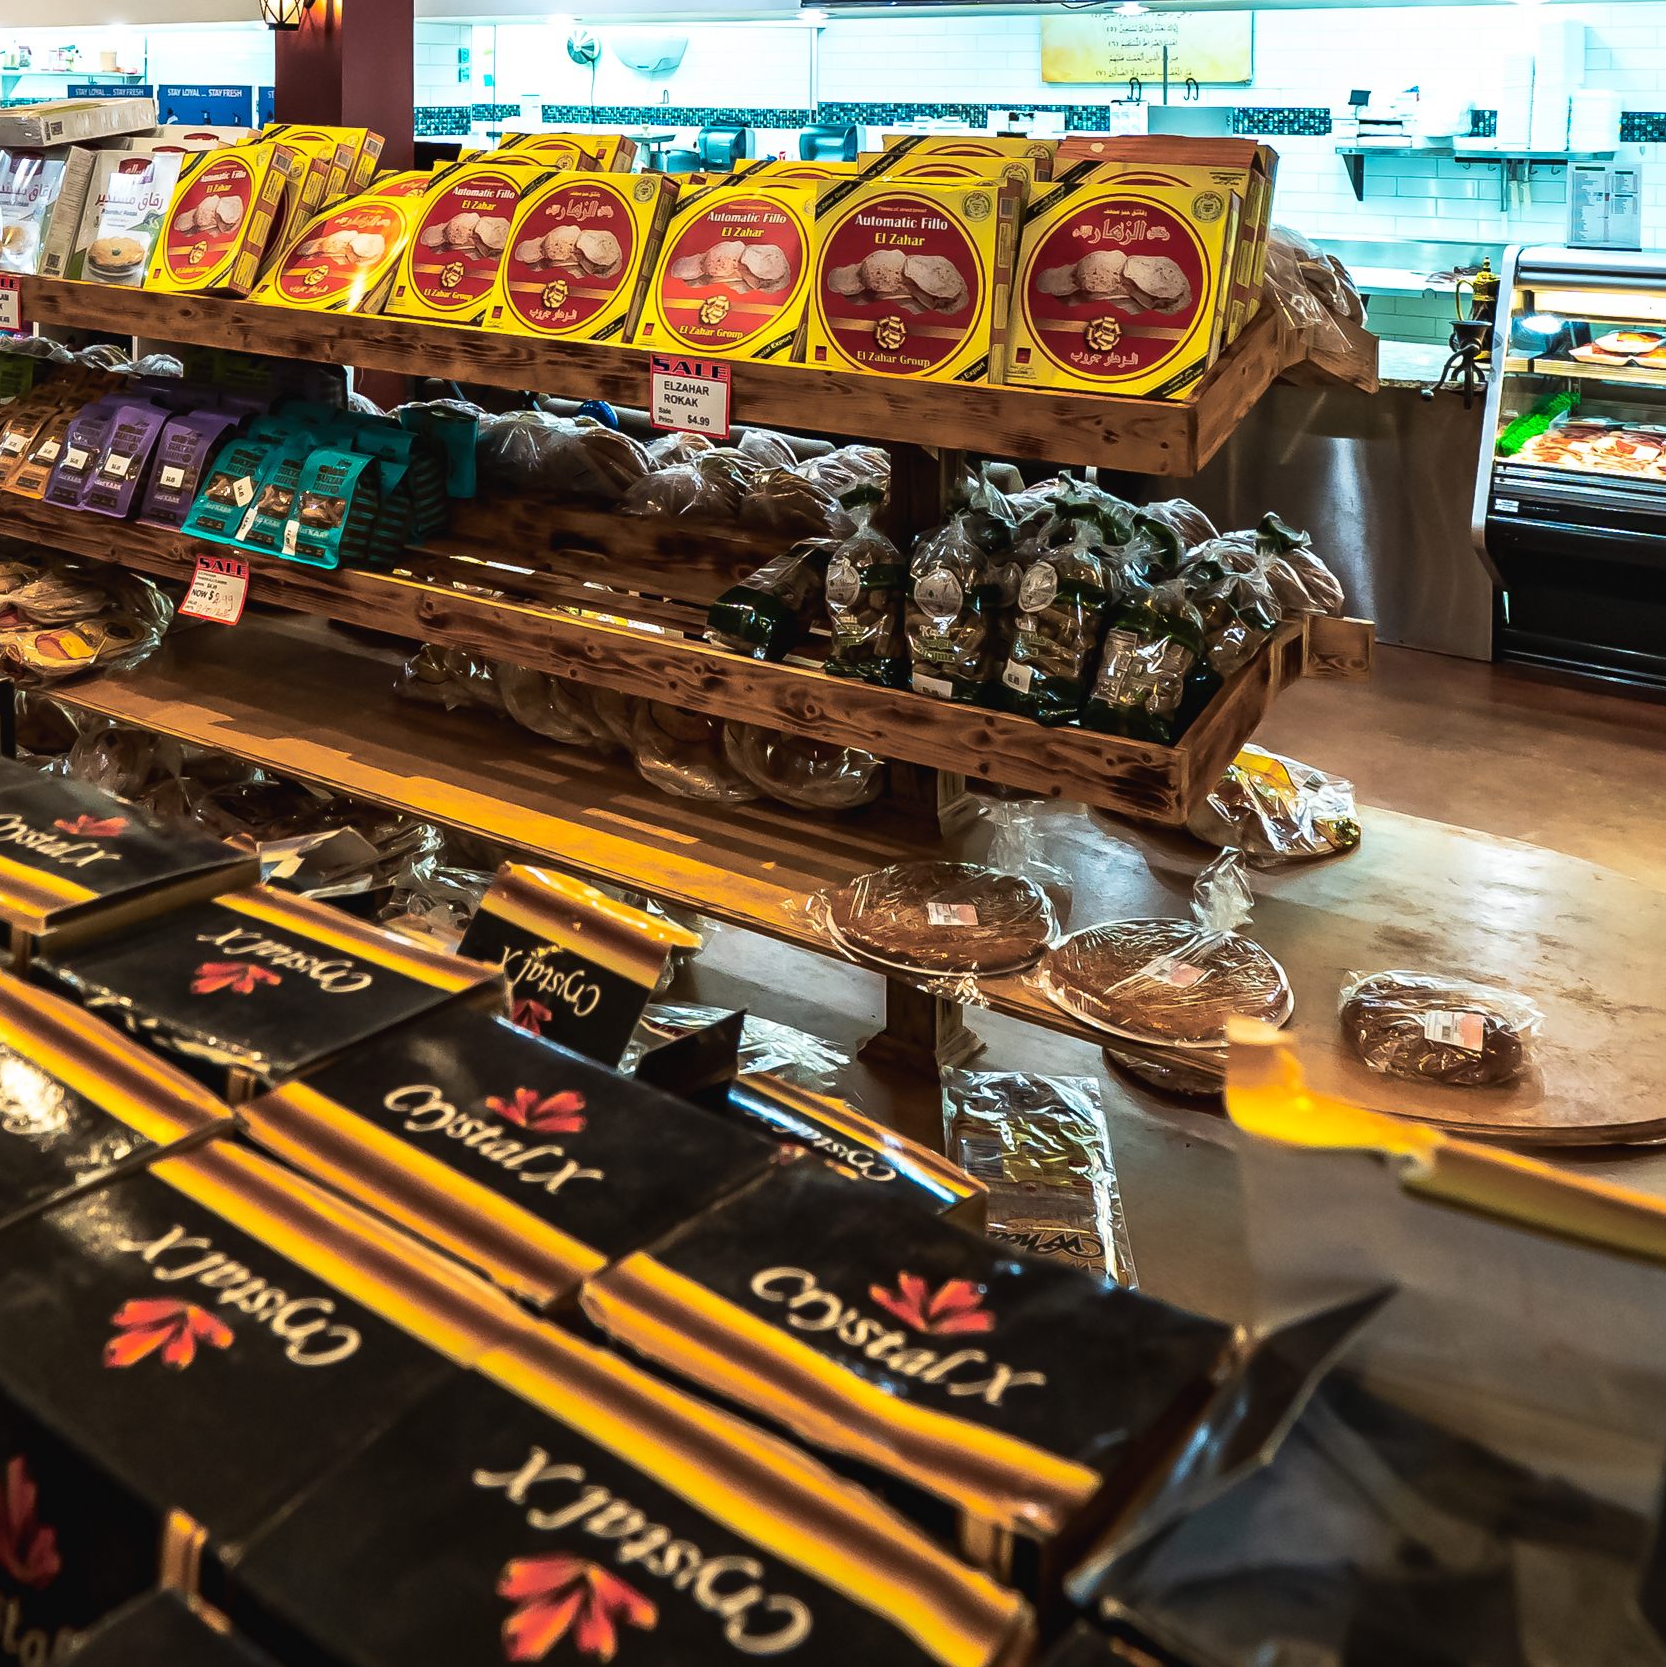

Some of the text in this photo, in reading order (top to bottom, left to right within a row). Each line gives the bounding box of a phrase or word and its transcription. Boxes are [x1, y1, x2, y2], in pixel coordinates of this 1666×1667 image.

[75, 88, 144, 96] STAY LOYAL STAY FRESH
[167, 88, 242, 97] STAY LOYAL STAY FRESH
[452, 187, 516, 199] Automatic Fillo
[461, 200, 497, 211] El Zahar
[707, 211, 786, 224] Automatic Fillo
[855, 214, 948, 231] Automatic Fillo
[722, 227, 764, 238] El Zahar
[875, 233, 925, 246] El Zahar
[679, 325, 743, 341] El Zahar Group
[770, 334, 793, 350] Export
[857, 351, 931, 368] El Zahar Group
[653, 356, 727, 381] SALE
[964, 361, 986, 380] Export
[664, 381, 709, 396] ELZAHAR
[664, 394, 698, 407] ROKAK
[687, 415, 710, 426] $4.99
[199, 558, 248, 576] SALE
[193, 589, 208, 598] NOW
[224, 936, 372, 993] Crystal
[517, 955, 601, 1017] Crystal
[384, 1084, 606, 1195] Crystal X
[118, 1225, 361, 1366] Crystal X
[751, 1268, 1047, 1406] Crystal X
[473, 1447, 812, 1655] Crystal X
